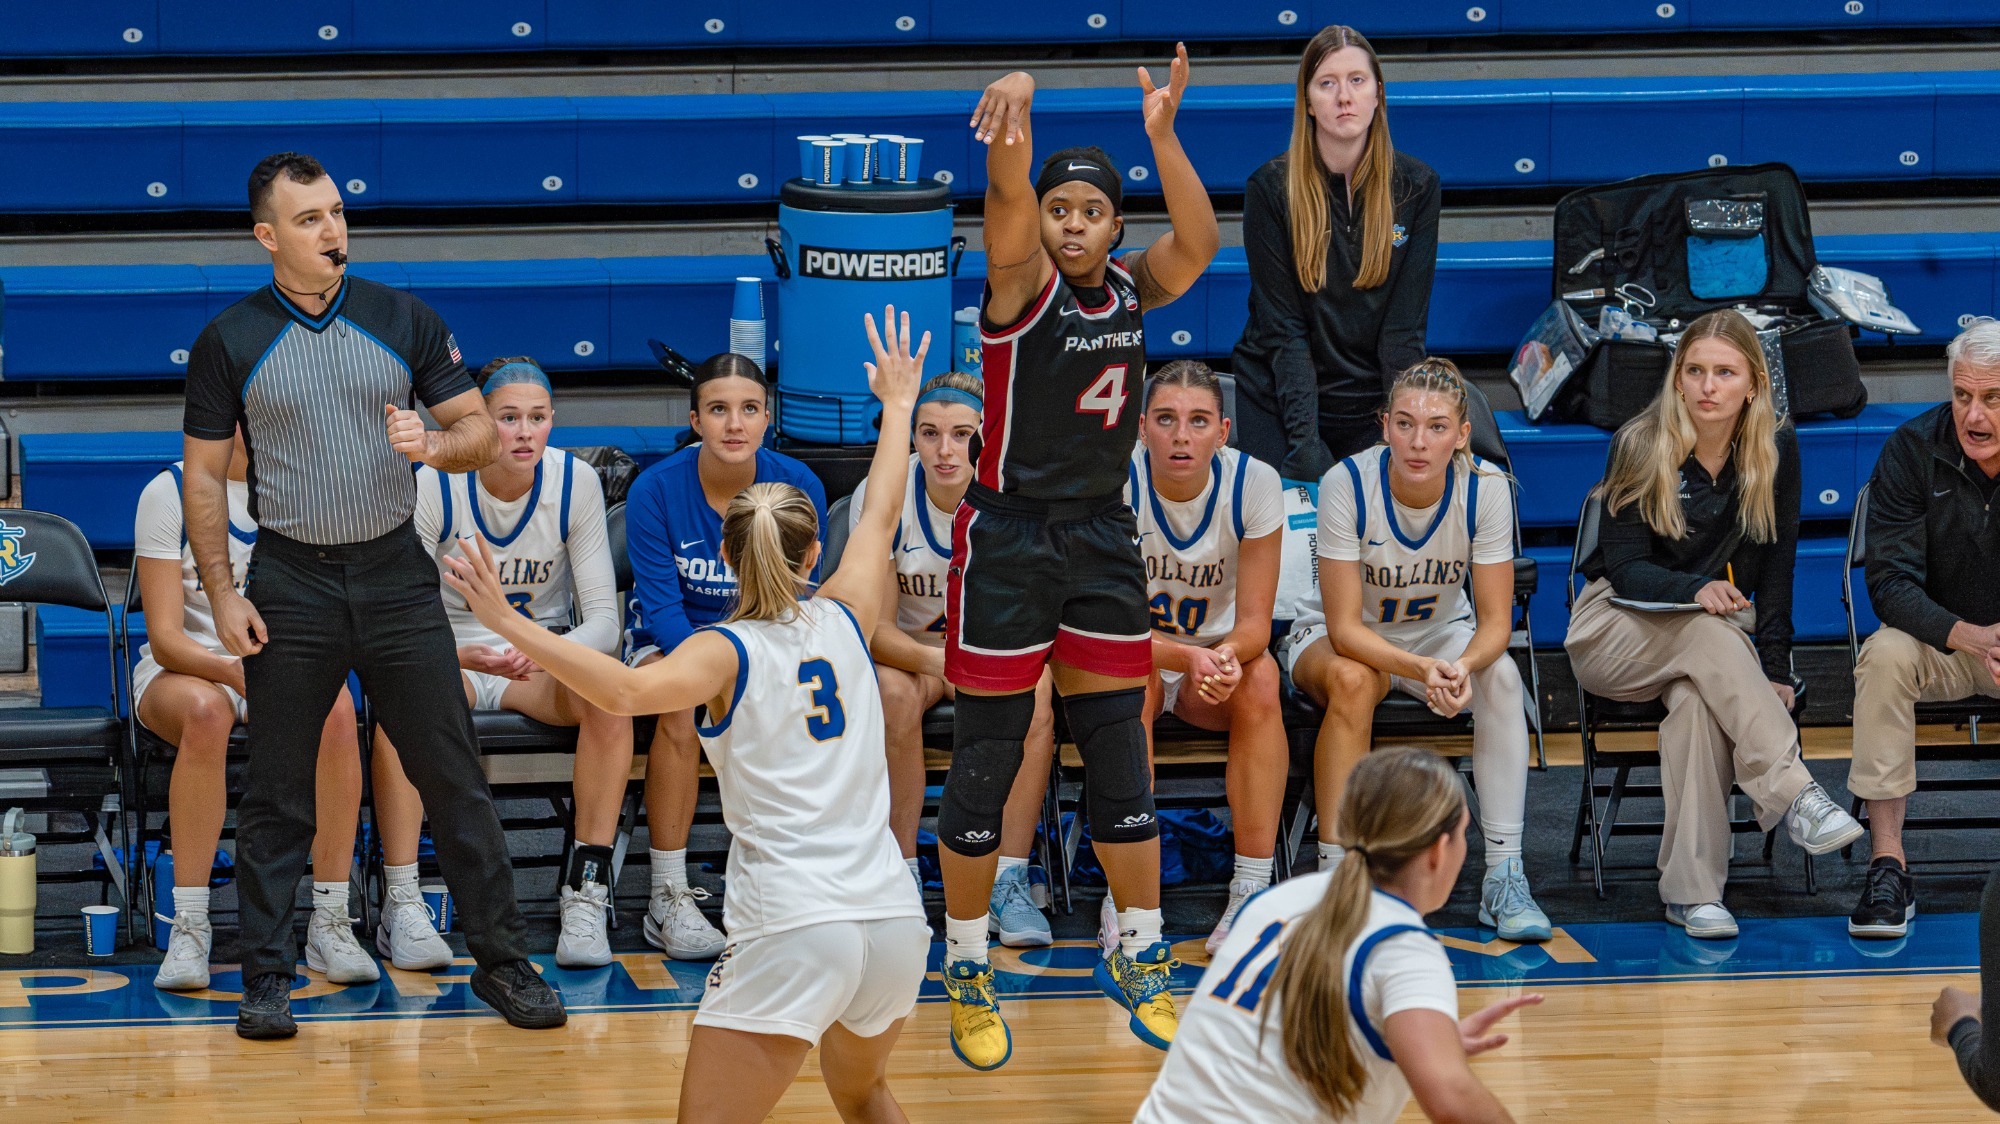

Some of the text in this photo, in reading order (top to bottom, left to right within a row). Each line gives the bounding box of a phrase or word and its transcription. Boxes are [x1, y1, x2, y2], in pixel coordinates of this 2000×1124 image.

[806, 250, 946, 277] POWERADE
[965, 348, 980, 363] R
[1075, 363, 1128, 430] 4
[1146, 554, 1225, 588] OLLINS
[1364, 558, 1465, 589] ROLLINS
[686, 583, 740, 597] BASKET
[1148, 591, 1210, 636] 20
[1379, 593, 1440, 624] 15
[797, 656, 847, 743] 3
